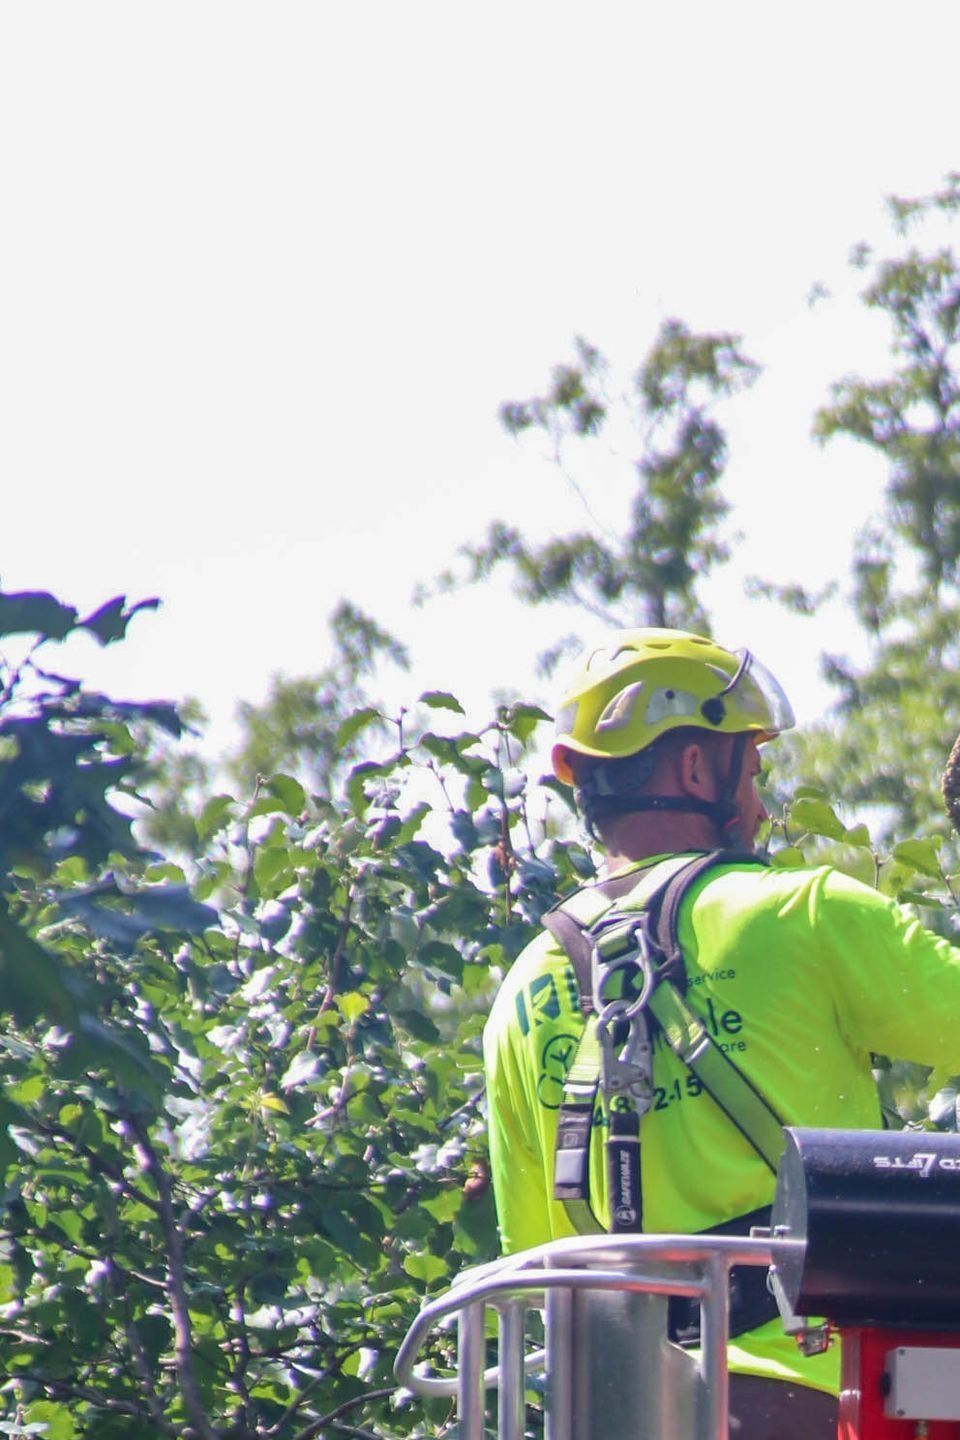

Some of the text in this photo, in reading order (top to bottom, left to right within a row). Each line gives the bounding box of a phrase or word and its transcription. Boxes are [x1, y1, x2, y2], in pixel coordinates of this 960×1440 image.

[687, 968, 735, 987] service
[719, 1040, 747, 1053] are
[873, 1152, 937, 1178] LIFTS
